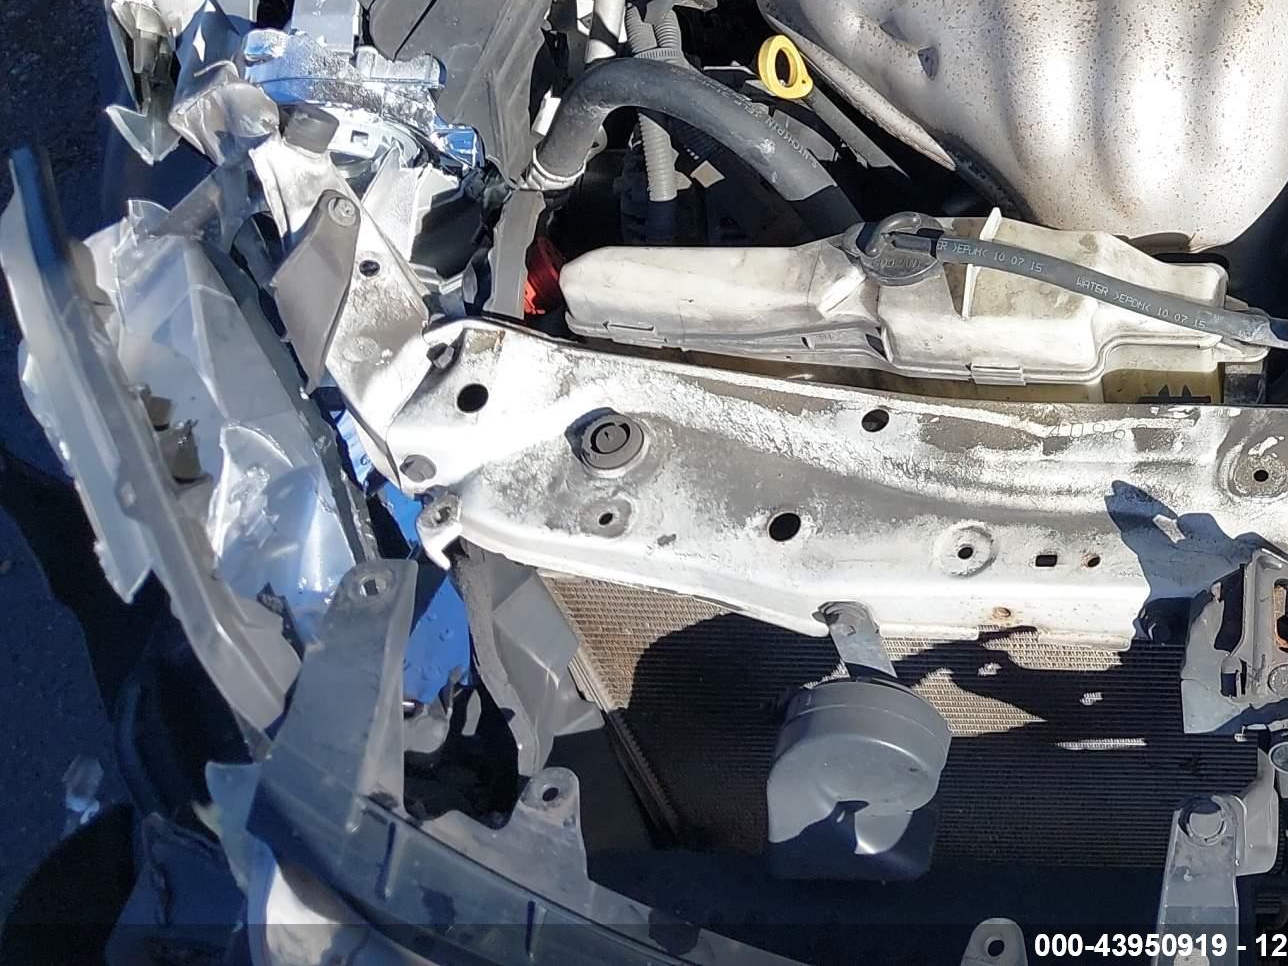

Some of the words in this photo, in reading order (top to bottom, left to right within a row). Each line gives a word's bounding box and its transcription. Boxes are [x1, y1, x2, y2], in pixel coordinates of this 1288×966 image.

[993, 251, 1006, 262] 10
[1030, 261, 1045, 273] 15
[1076, 276, 1109, 297] WATER
[1156, 307, 1169, 318] 10
[1174, 313, 1188, 324] 07
[1193, 319, 1207, 329] 15
